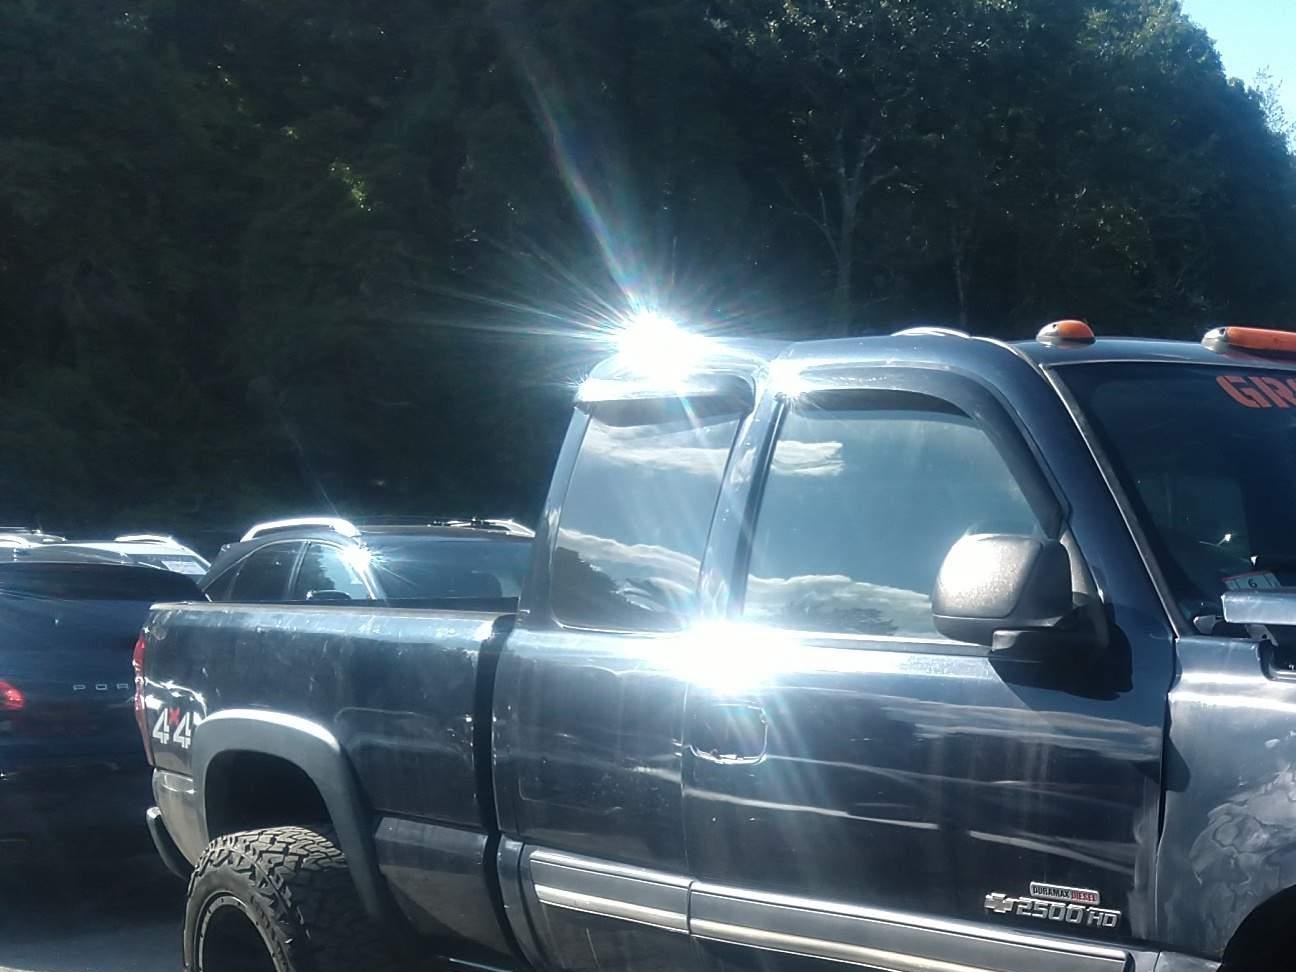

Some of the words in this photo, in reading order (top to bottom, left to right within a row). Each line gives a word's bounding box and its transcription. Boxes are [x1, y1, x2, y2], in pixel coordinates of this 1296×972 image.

[1033, 886, 1071, 900] DURAMAX
[1071, 889, 1098, 903] DIESEL
[1016, 896, 1086, 924] 2500
[1086, 906, 1122, 928] HD
